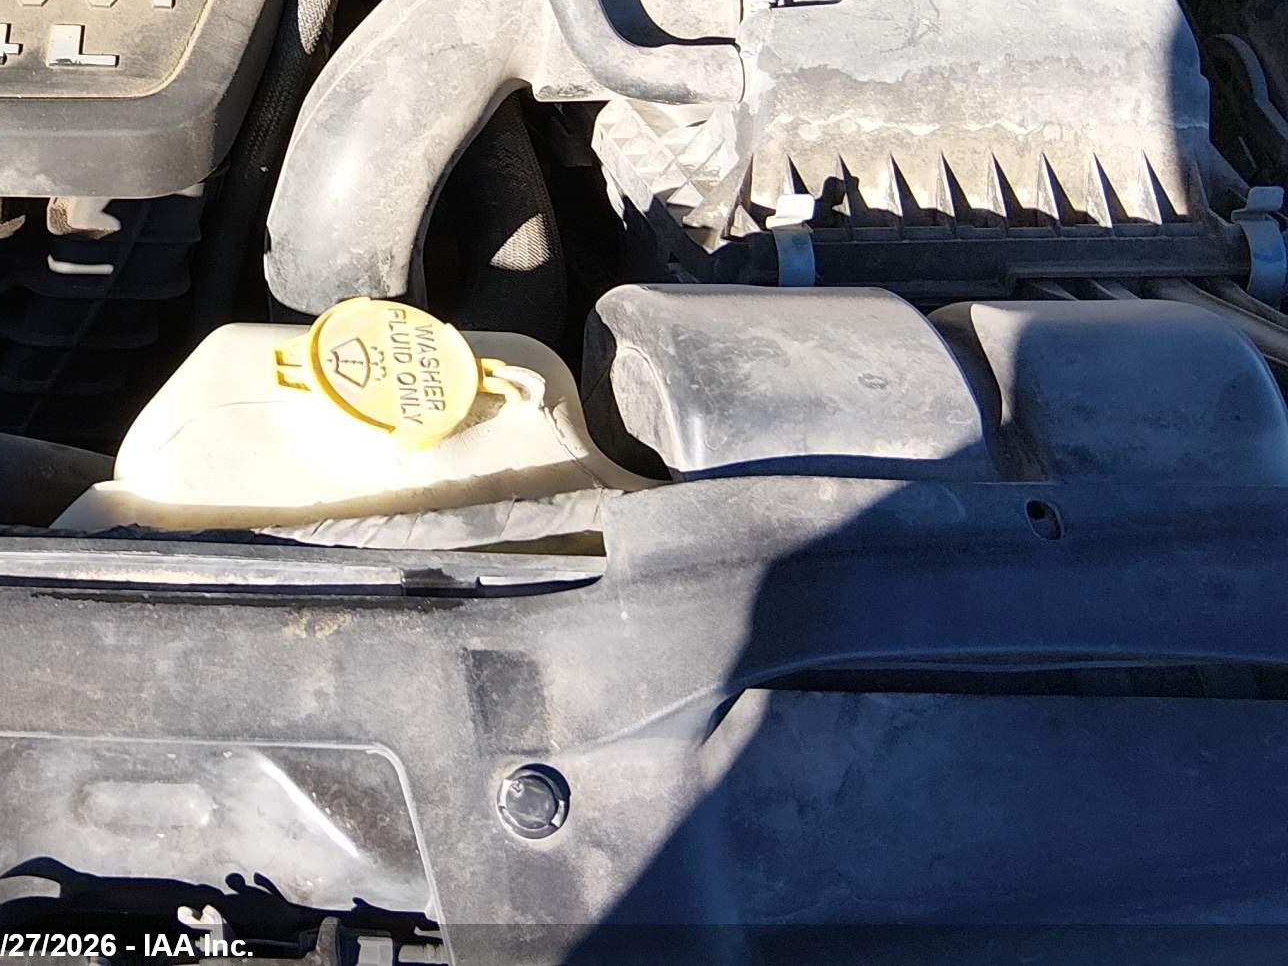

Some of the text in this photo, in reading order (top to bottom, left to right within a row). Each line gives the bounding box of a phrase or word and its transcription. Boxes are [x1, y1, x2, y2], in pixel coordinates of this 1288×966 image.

[388, 308, 423, 425] FLUID ONLY
[414, 324, 446, 411] WASHER
